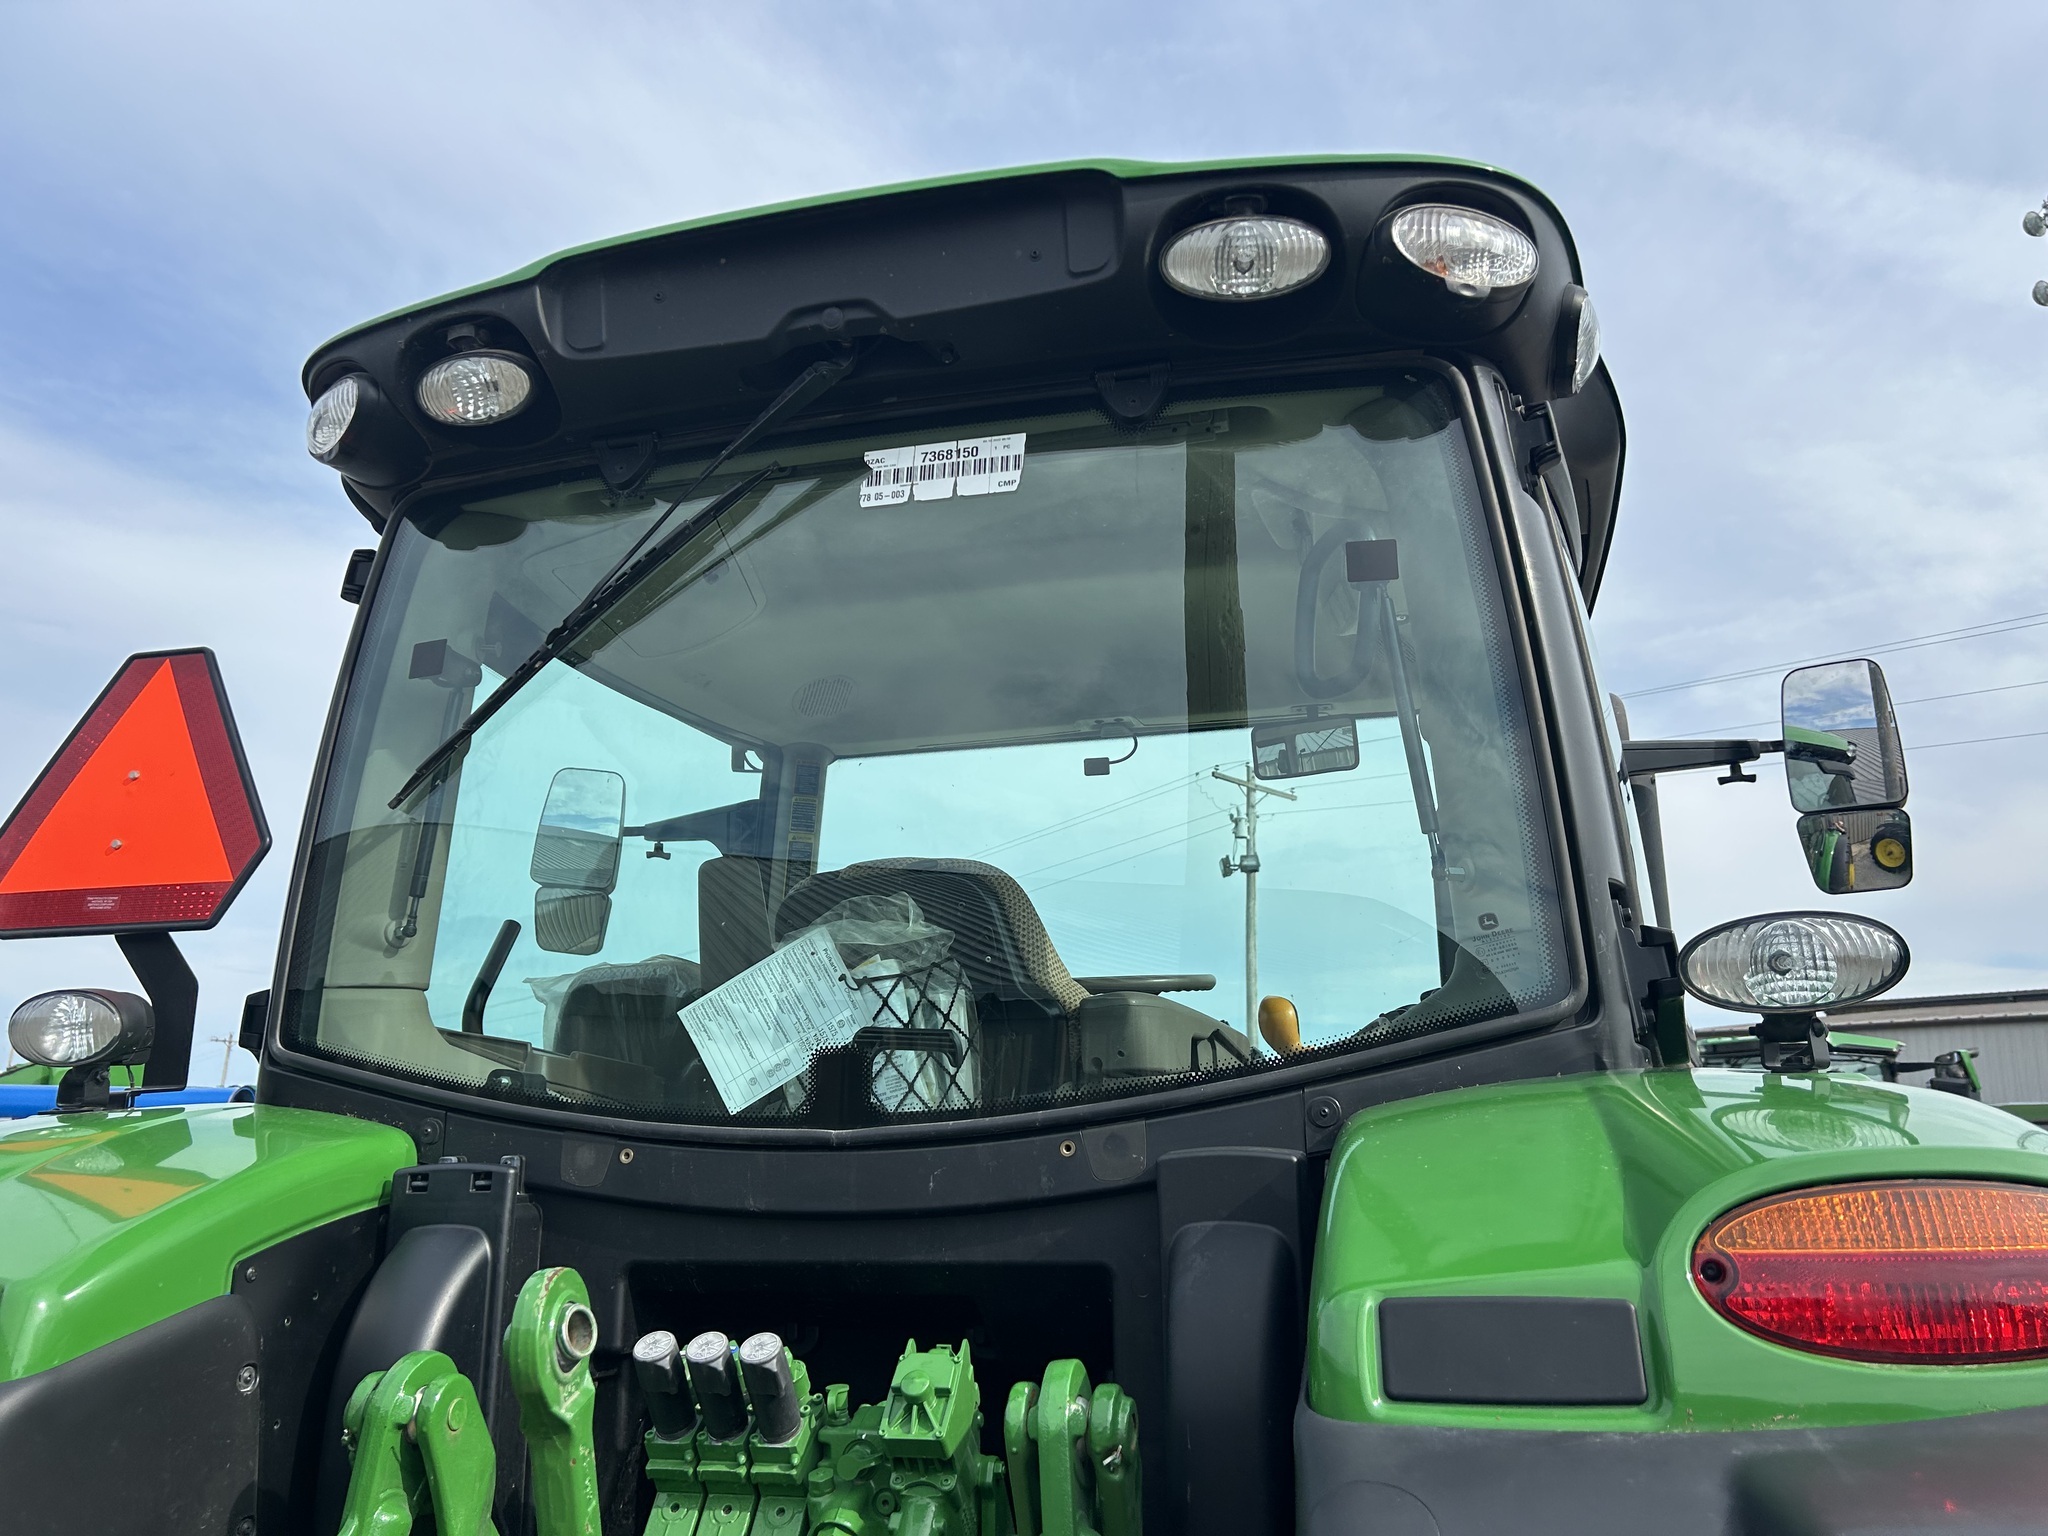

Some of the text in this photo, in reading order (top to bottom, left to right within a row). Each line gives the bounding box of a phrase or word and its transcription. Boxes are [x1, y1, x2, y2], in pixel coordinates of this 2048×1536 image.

[921, 446, 979, 463] 7368150
[1491, 928, 1513, 936] DEERE
[822, 947, 859, 1010] Prüfkarte Checklist
[826, 1021, 838, 1036] 1575
